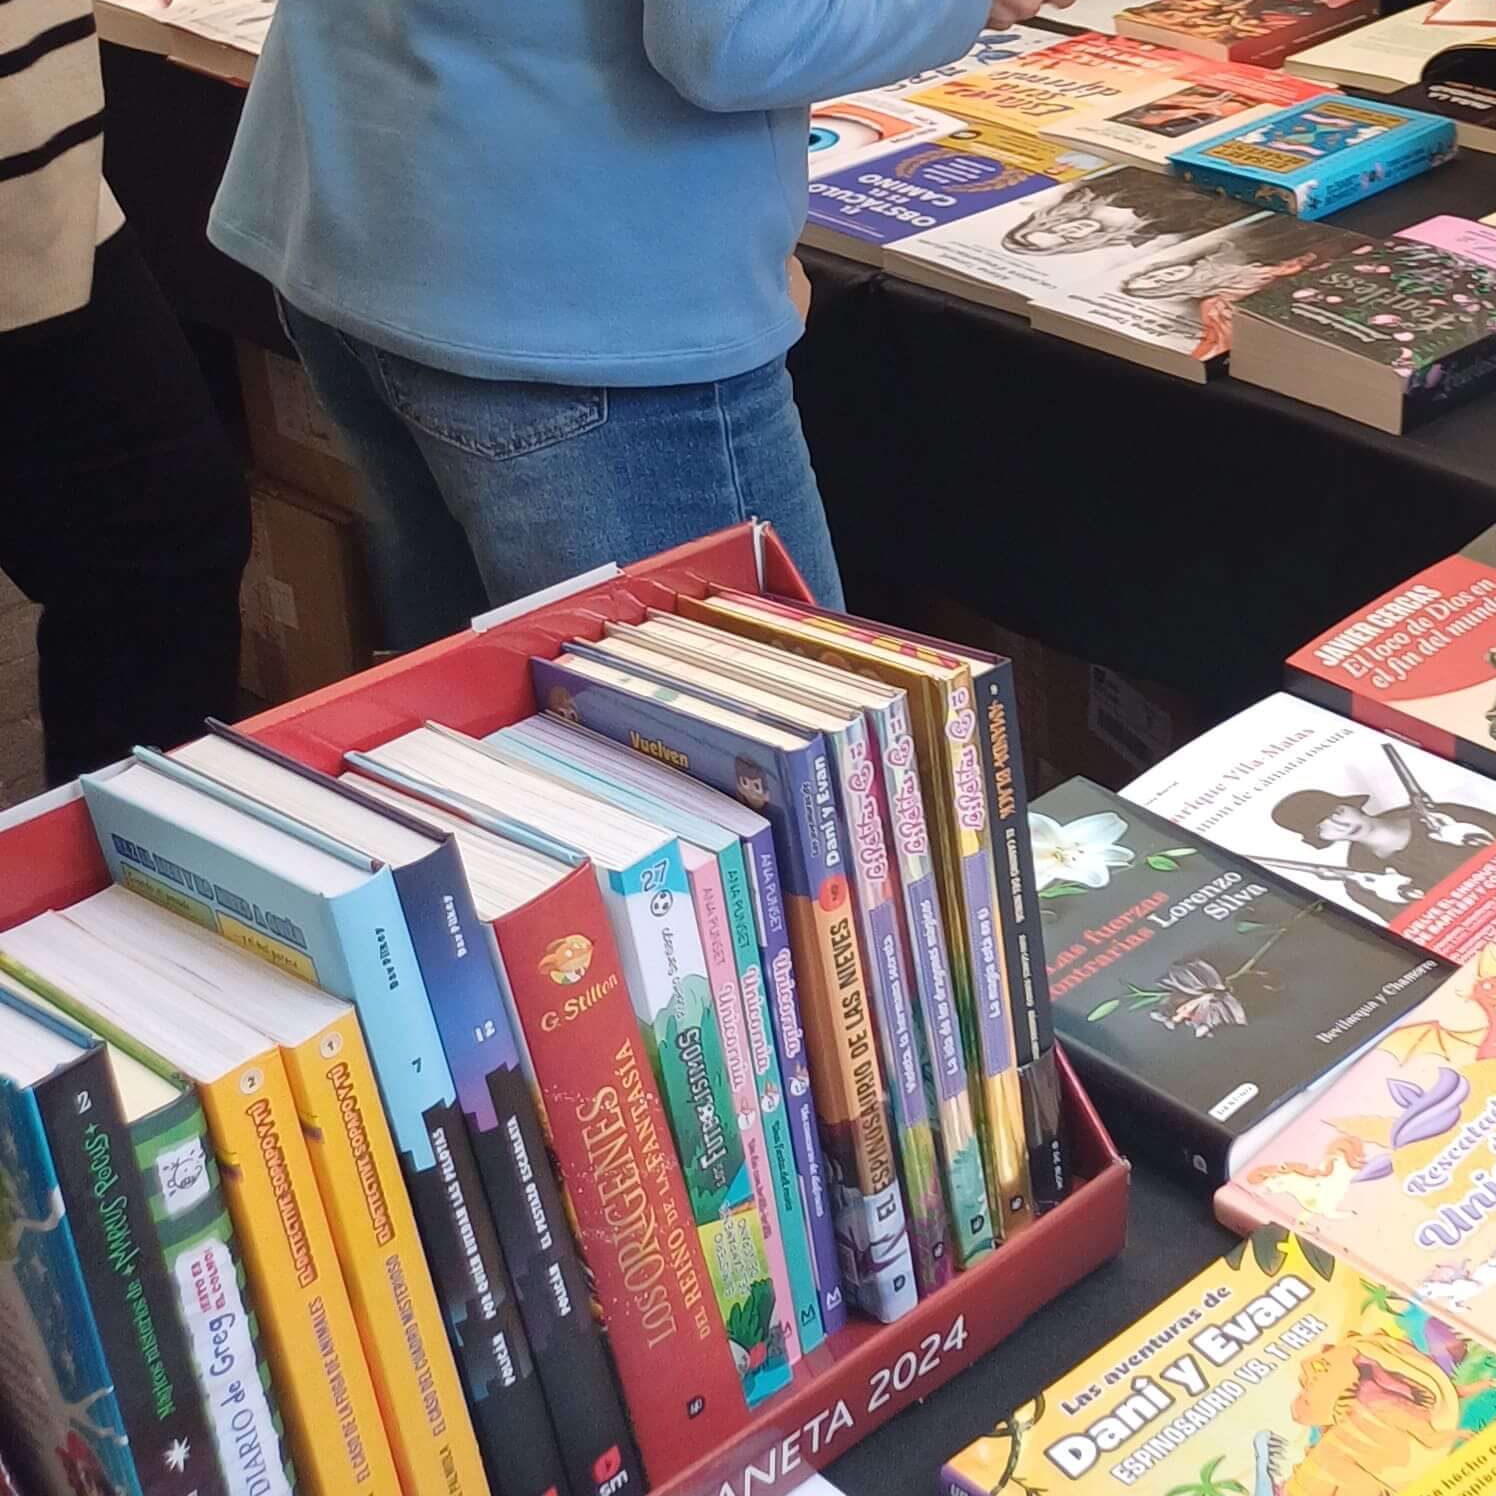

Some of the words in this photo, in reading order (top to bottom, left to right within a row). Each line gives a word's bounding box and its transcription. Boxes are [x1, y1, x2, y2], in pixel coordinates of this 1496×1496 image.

[857, 173, 957, 207] CAMINO
[1313, 620, 1386, 668] JAVIER
[1365, 584, 1443, 629] CERCAS
[1341, 653, 1374, 679] El
[1366, 632, 1412, 662] loco
[1406, 615, 1437, 637] de
[1425, 590, 1477, 622] Dios
[1371, 667, 1396, 689] el
[1386, 652, 1426, 682] fin
[1417, 628, 1453, 656] del
[950, 688, 968, 709] 10
[627, 729, 690, 769] Vuelven
[813, 755, 832, 805] Evan
[1223, 726, 1317, 784] Vila-Matas
[1252, 753, 1308, 801] cámara
[1301, 725, 1357, 766] oscura
[639, 856, 670, 895] 27
[819, 822, 842, 869] Dani
[765, 882, 784, 934] PUNSET
[1146, 870, 1245, 931] Lorenzo
[1201, 881, 1269, 924] Silva
[1450, 864, 1496, 900] ENRIQUE
[1082, 889, 1171, 947] fuerzas
[829, 916, 862, 991] NIEVES
[1050, 926, 1156, 1002] ontrarias
[562, 972, 621, 1022] Stilton
[742, 965, 770, 1075] Unicornia
[771, 947, 801, 1059] Unicornia
[842, 990, 868, 1030] LAS
[1315, 1001, 1379, 1046] Bevilacqua
[1383, 958, 1441, 1000] Chamorro
[474, 1019, 497, 1044] 12
[716, 980, 745, 1092] Unicornia
[847, 1033, 869, 1059] DE
[411, 1056, 424, 1075] 7
[75, 1089, 93, 1115] 2
[338, 1095, 372, 1160] SOPAPO
[613, 1037, 665, 1178] FANTASÍA
[851, 1059, 895, 1196] ESPINOSAURIO
[261, 1133, 293, 1199] SOPAPO
[355, 1156, 391, 1232] DETECTIVE
[276, 1195, 311, 1273] DETECTIVE
[874, 1191, 898, 1223] EL
[385, 1253, 417, 1326] MISTERIOSO
[671, 1227, 706, 1312] REINO
[209, 1312, 236, 1378] Greg
[308, 1293, 337, 1359] ANIMALES
[641, 1287, 677, 1351] LOS
[693, 1308, 711, 1343] DEL
[867, 1311, 970, 1405] 2024
[1043, 1375, 1177, 1481] Dani
[1188, 1273, 1316, 1368] Evan
[1059, 1382, 1104, 1417] Las
[1103, 1308, 1204, 1386] aventuras
[1201, 1285, 1233, 1310] de
[220, 1378, 249, 1408] de
[421, 1388, 442, 1420] CASO
[1109, 1378, 1247, 1486] ESPINOSAURIO
[1279, 1312, 1329, 1350] REX
[237, 1405, 273, 1496] DIARIO
[347, 1435, 368, 1470] CASO
[1440, 1453, 1489, 1491] hecho
